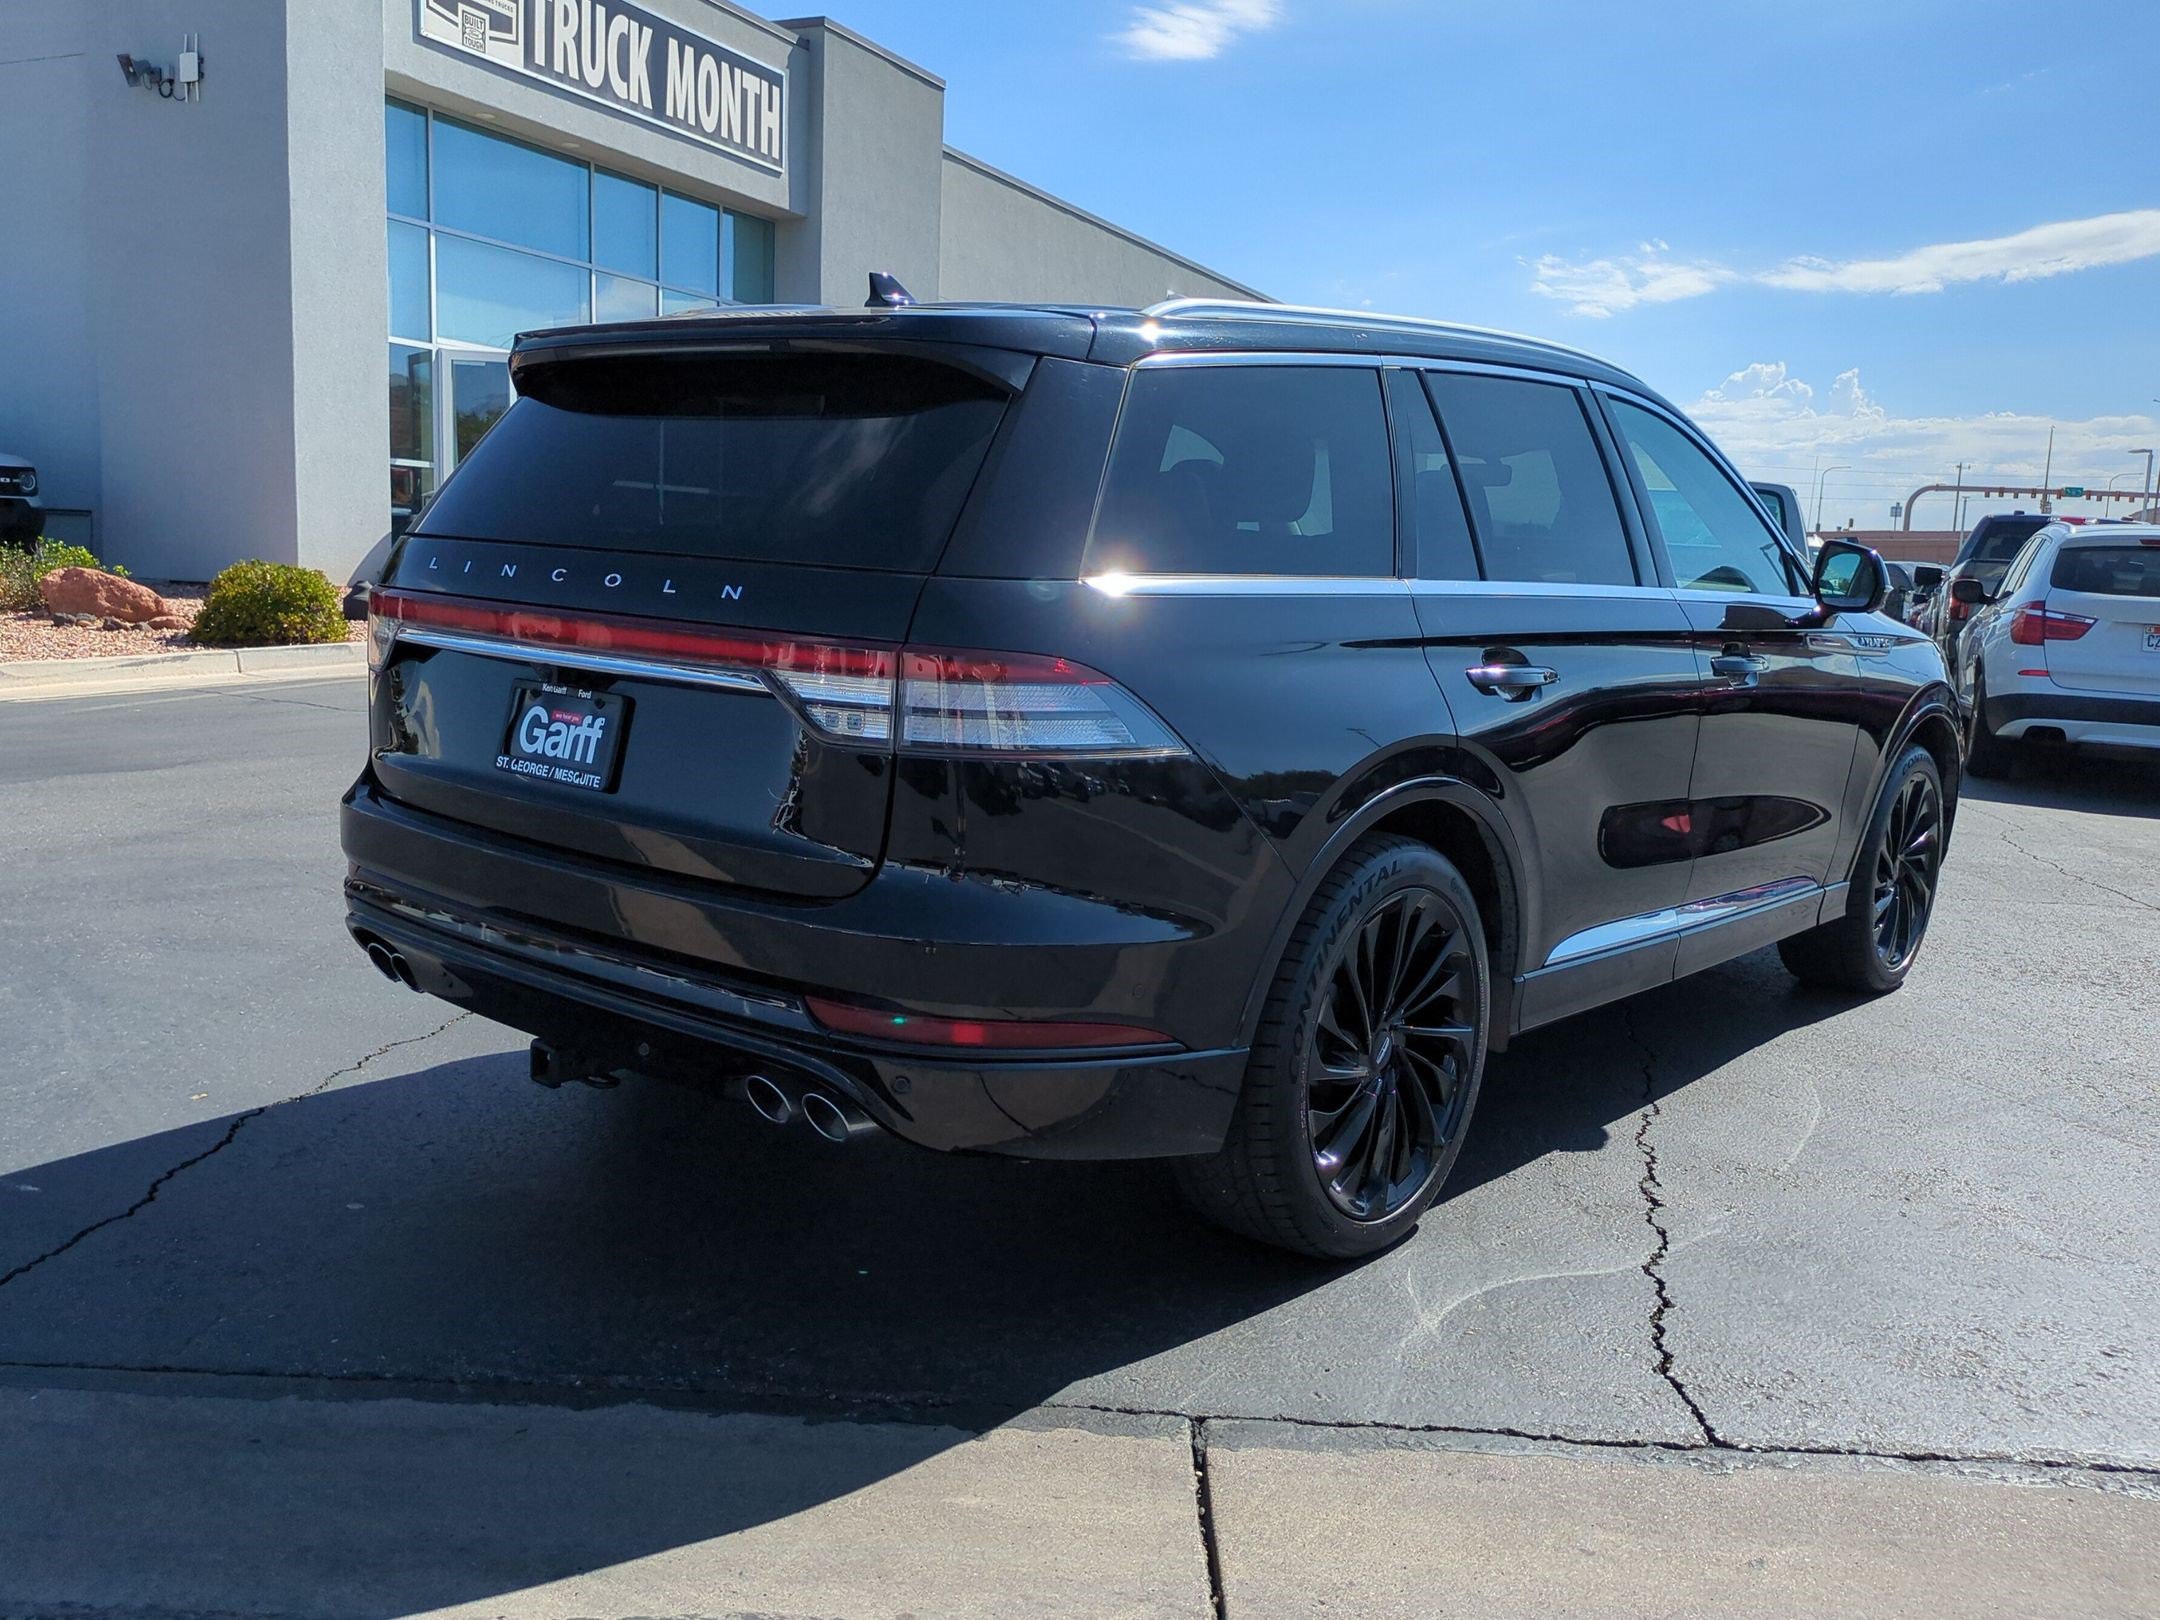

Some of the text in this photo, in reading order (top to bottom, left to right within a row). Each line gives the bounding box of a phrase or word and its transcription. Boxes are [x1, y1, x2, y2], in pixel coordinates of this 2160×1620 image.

[464, 14, 484, 30] BUILT
[464, 36, 484, 49] TOUGH
[534, 0, 780, 160] TRUCK MONTH
[429, 557, 743, 600] LINCOLN
[578, 689, 592, 699] Ford
[520, 705, 606, 764] Garff
[496, 756, 509, 769] ST.
[510, 758, 549, 777] GEORGE
[554, 768, 601, 788] MESQUITE
